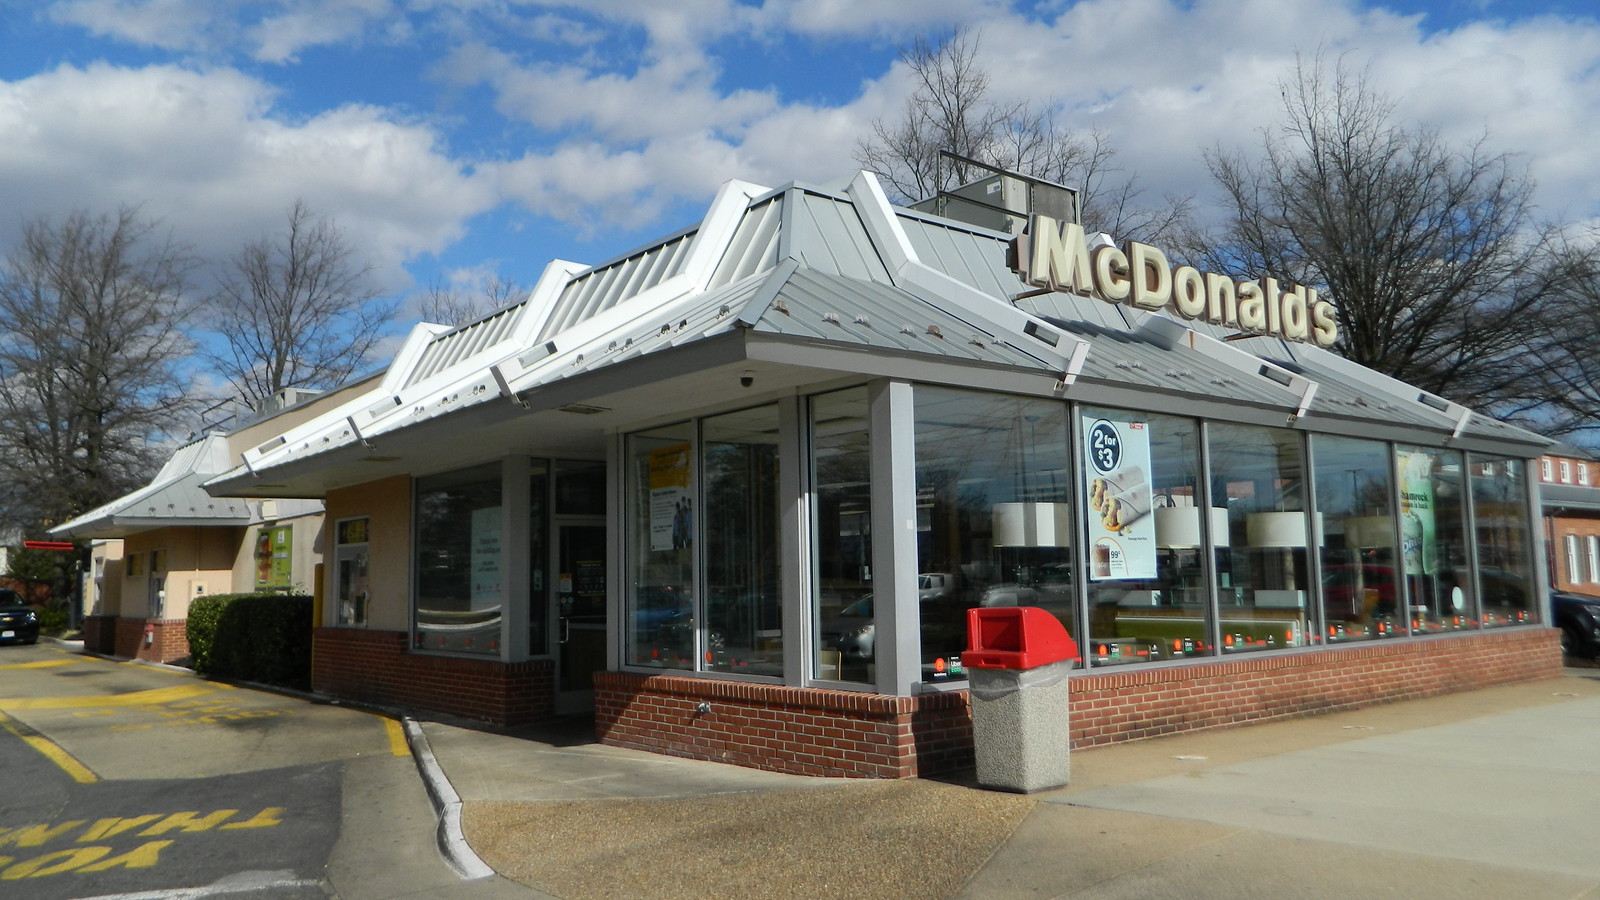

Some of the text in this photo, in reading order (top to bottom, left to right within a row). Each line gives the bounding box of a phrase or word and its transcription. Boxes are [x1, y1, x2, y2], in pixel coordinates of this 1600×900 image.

[1029, 213, 1338, 345] McDonald's
[1094, 429, 1116, 449] 2 for
[1098, 448, 1113, 469] $3
[1401, 490, 1428, 502] hamrock
[0, 839, 175, 880] YO
